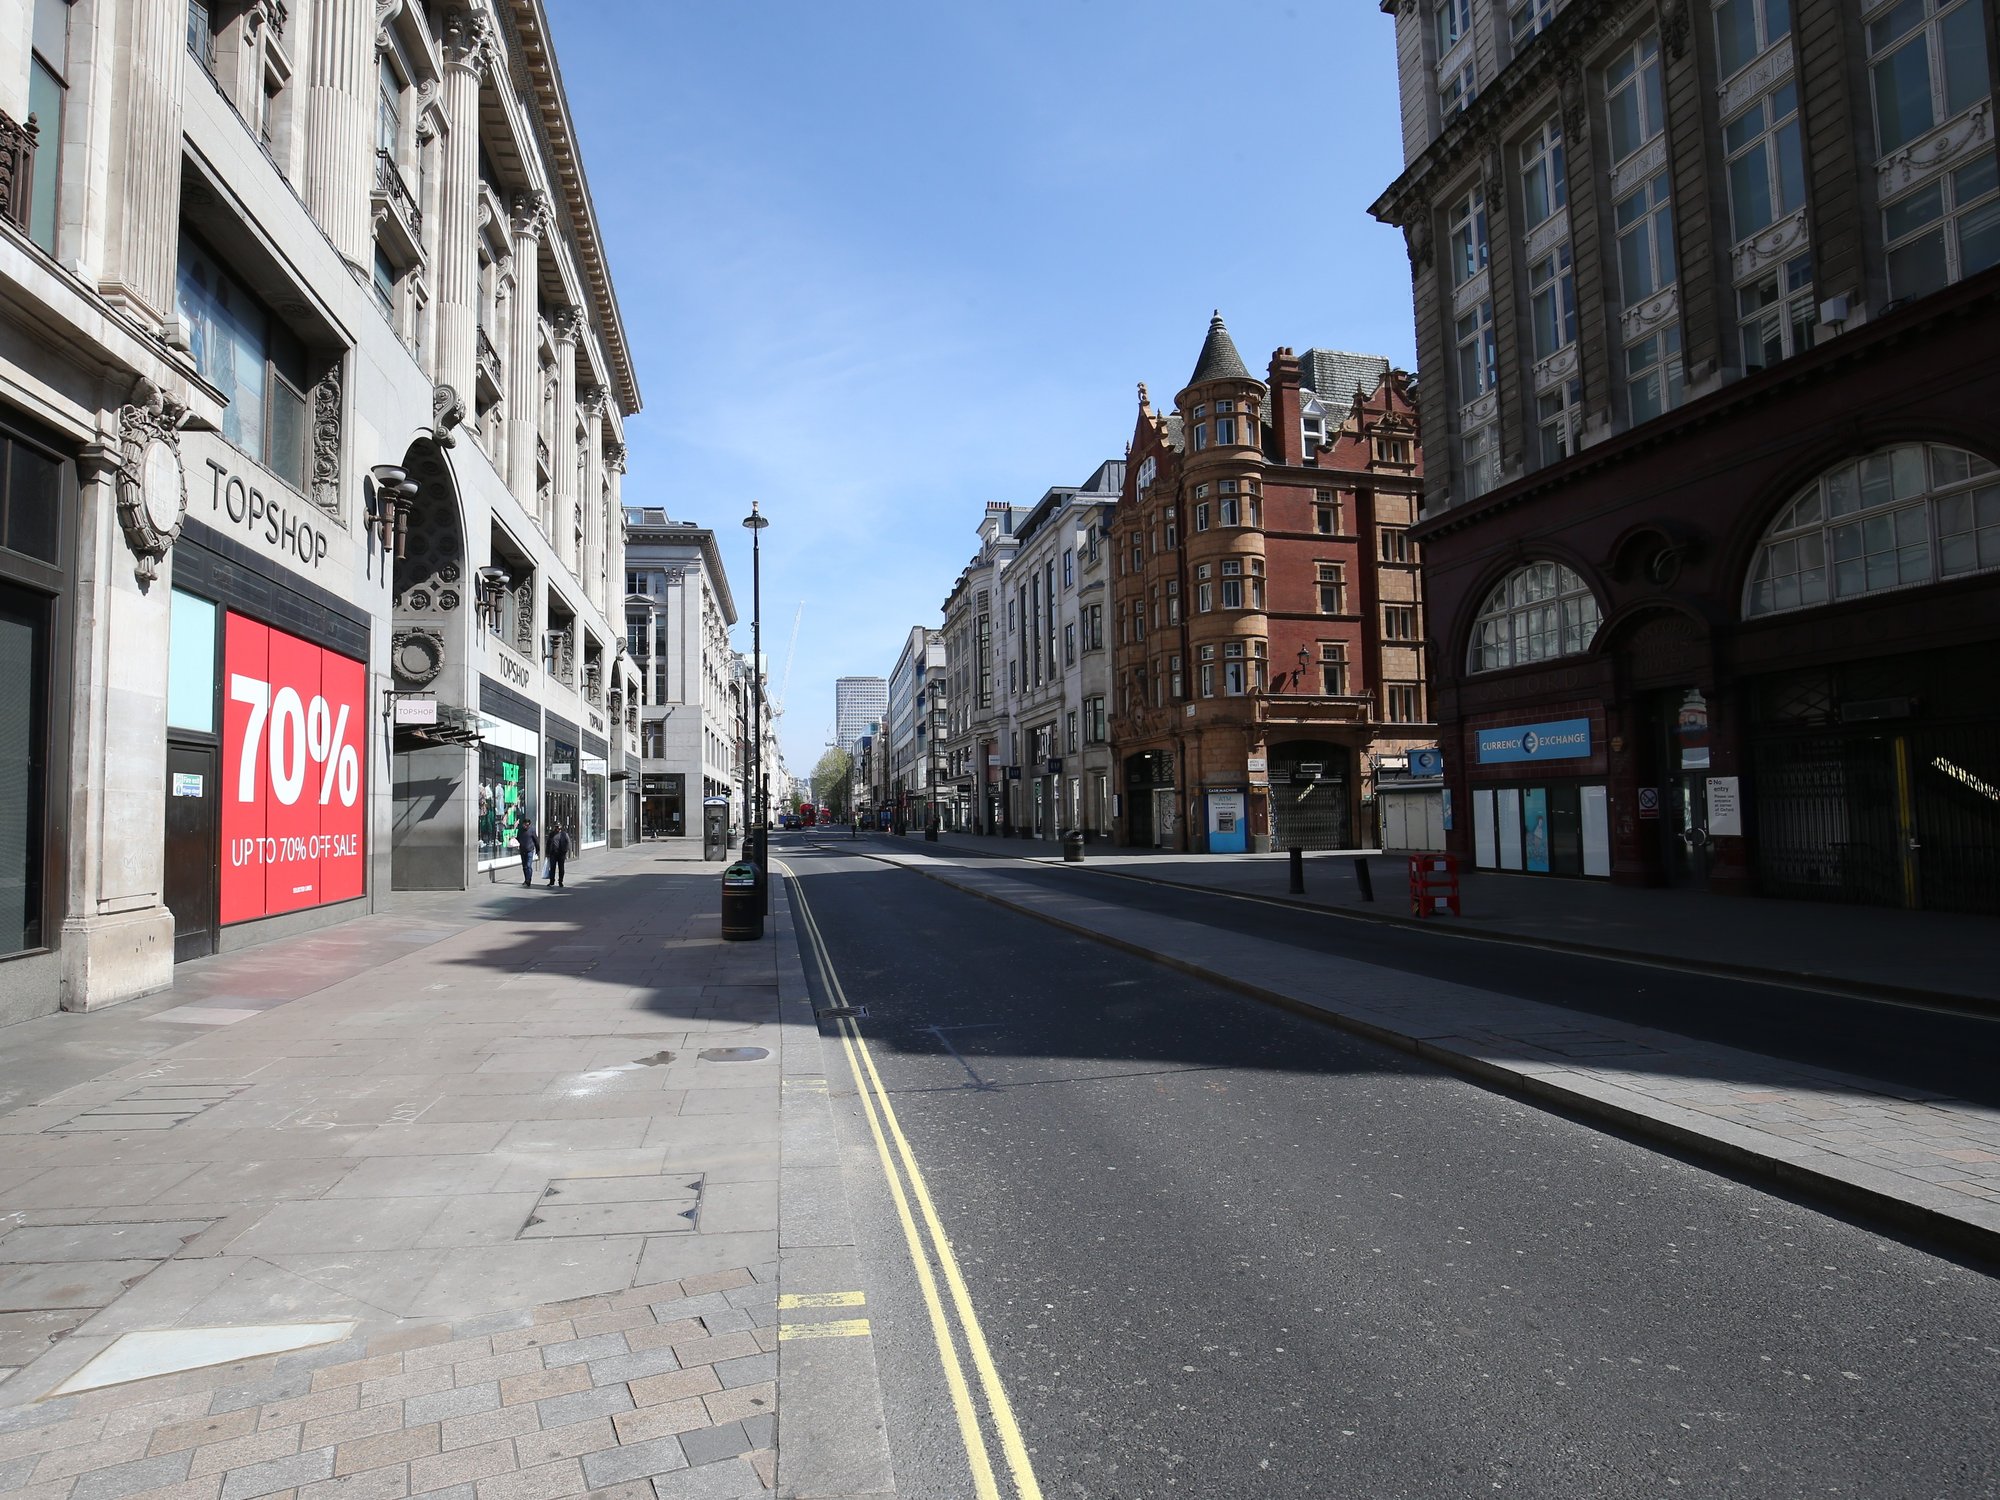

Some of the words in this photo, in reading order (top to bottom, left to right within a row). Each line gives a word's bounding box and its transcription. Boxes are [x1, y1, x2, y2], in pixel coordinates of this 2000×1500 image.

[205, 457, 328, 569] TOPSHOP
[498, 652, 530, 689] TOPSHOP
[398, 708, 434, 716] TOPSHOP
[230, 672, 358, 808] 70%
[1482, 738, 1522, 751] CURRENCY
[1539, 732, 1585, 747] EXCHANGE
[502, 762, 519, 782] TREAT
[231, 838, 254, 867] UP
[256, 836, 276, 865] TO
[279, 836, 307, 863] 70%
[309, 834, 331, 860] OFF
[333, 833, 357, 858] SALE
